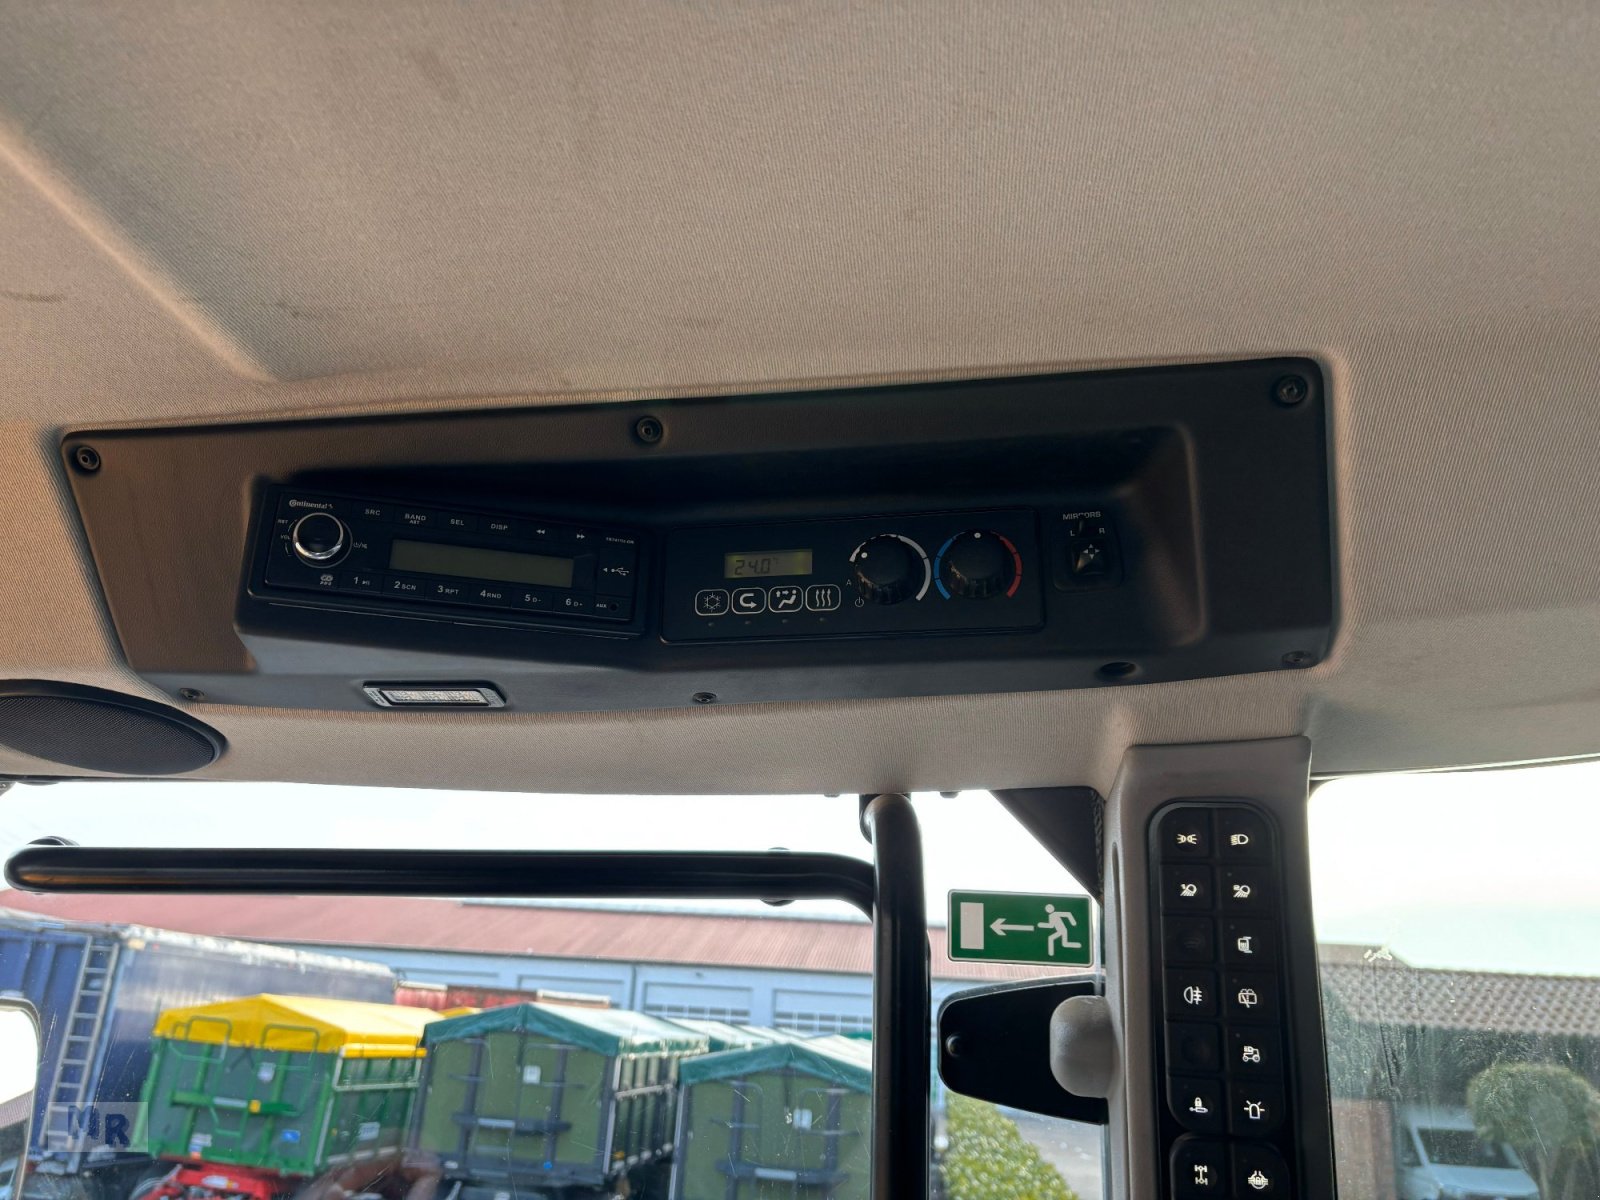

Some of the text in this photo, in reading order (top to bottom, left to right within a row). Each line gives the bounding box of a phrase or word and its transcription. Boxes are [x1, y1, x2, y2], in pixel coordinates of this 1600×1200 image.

[289, 499, 328, 509] Continental
[365, 508, 381, 516] SRC
[404, 513, 427, 522] BAND
[450, 518, 465, 526] SEL
[490, 522, 508, 531] DISP
[353, 576, 358, 585] 1
[394, 581, 417, 591] 2 SCN
[437, 585, 444, 593] 3
[480, 589, 486, 598] 4
[524, 594, 531, 602] 5
[565, 598, 572, 607] 6
